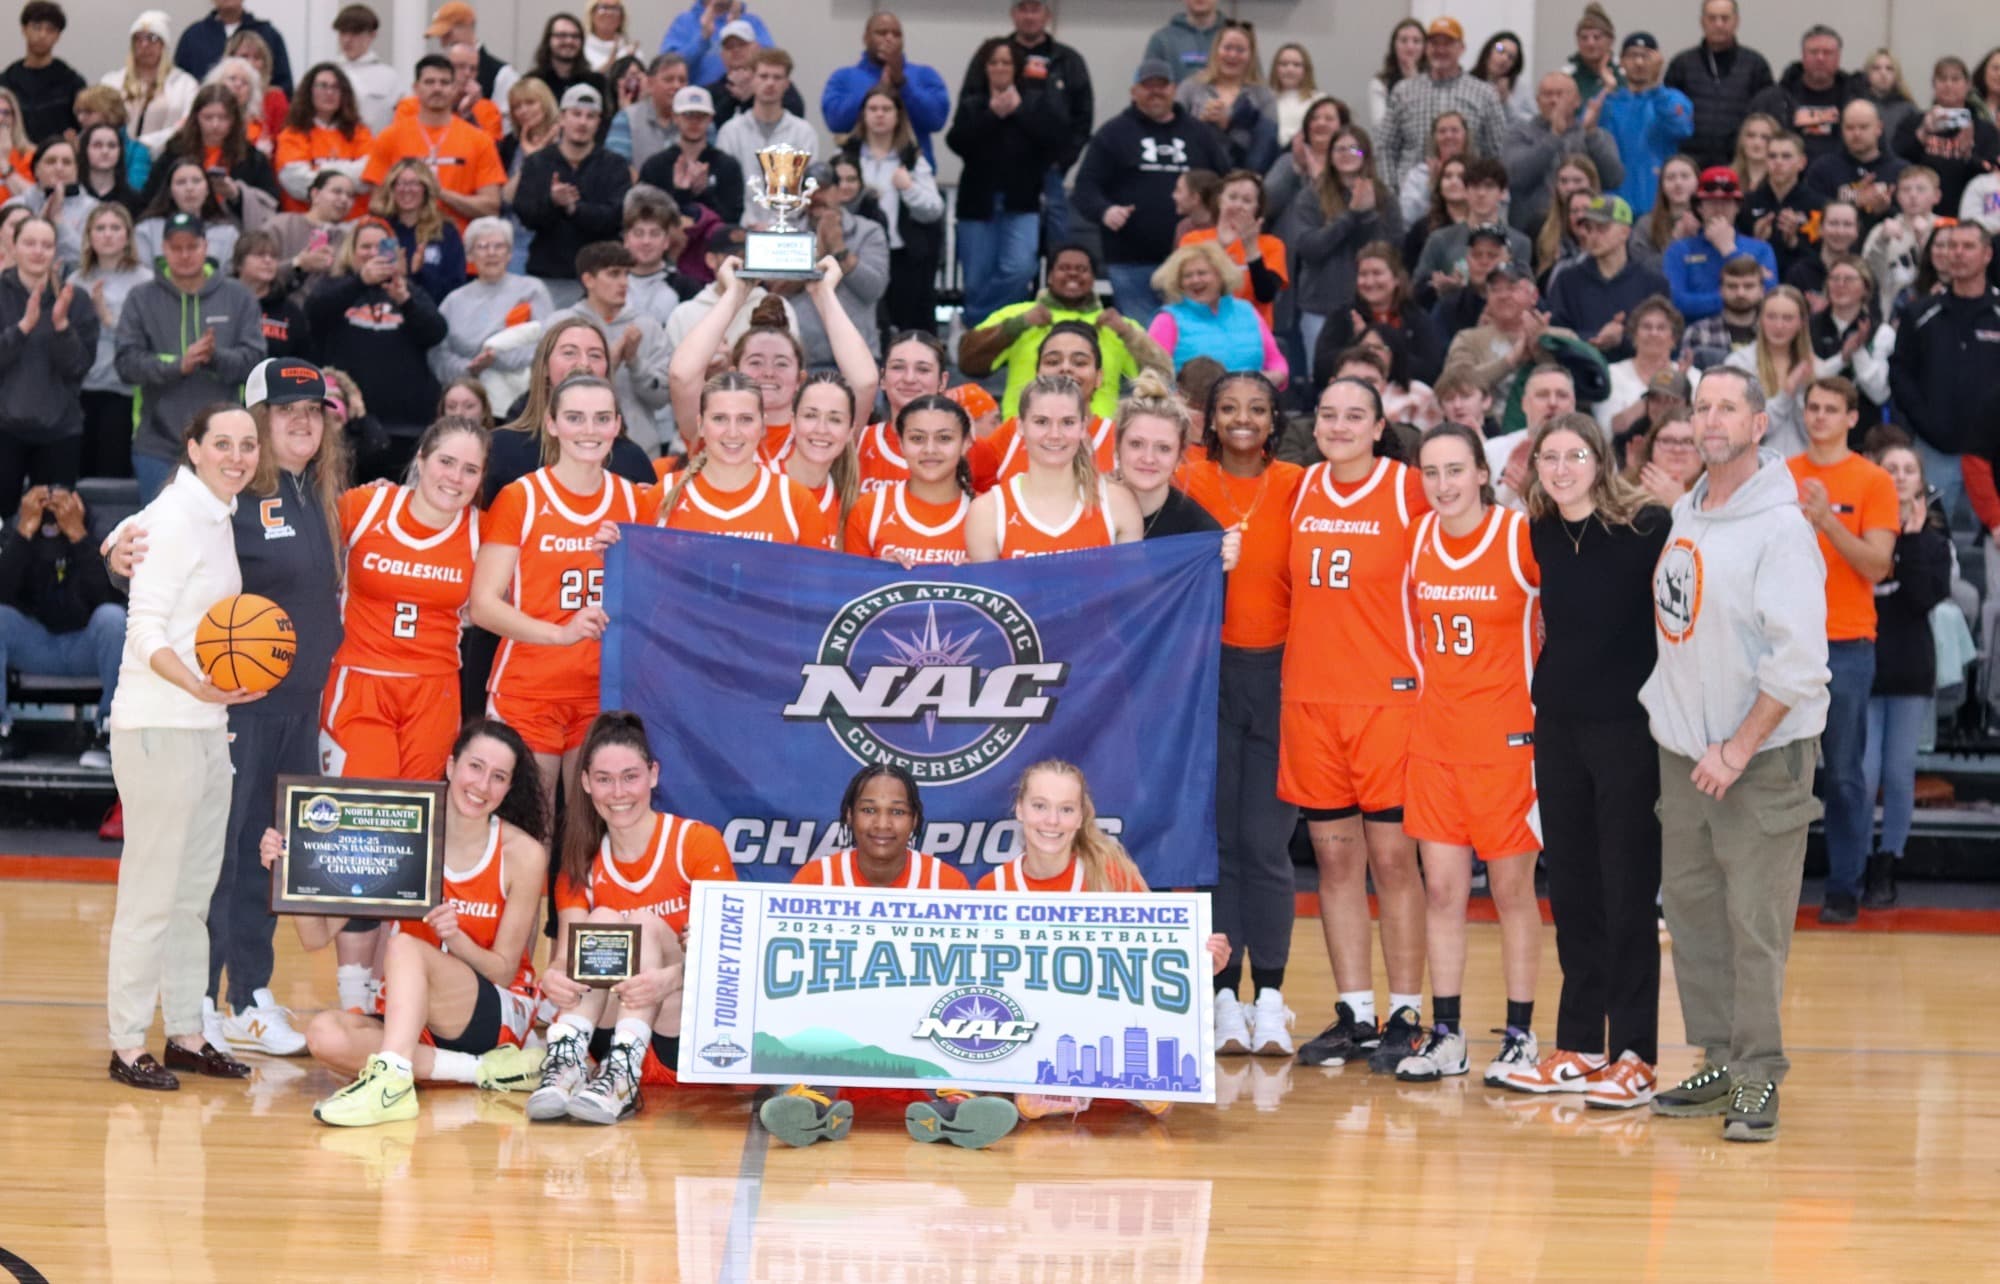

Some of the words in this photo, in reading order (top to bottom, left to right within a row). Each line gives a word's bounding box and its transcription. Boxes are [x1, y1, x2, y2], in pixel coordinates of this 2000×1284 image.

[261, 498, 284, 528] C
[1299, 516, 1381, 535] COBLESKILL
[539, 534, 594, 552] COBLE
[362, 552, 464, 584] COBLESKILL
[1309, 547, 1352, 590] 12
[560, 568, 605, 611] 25
[1416, 581, 1498, 601] COBLESKILL
[393, 601, 419, 639] 2
[830, 591, 904, 652] NORTH
[916, 587, 1033, 651] ATLANTIC
[1431, 613, 1475, 656] 13
[782, 662, 1069, 719] NAC
[846, 725, 1013, 777] CONFERENCE
[303, 811, 342, 823] NAC
[344, 808, 373, 818] NORTH
[375, 809, 416, 819] ATLANTIC
[352, 817, 408, 827] CONFERENCE
[304, 841, 349, 852] WOMEN'S
[350, 844, 414, 855] BASKETBALL
[338, 835, 380, 846] 2024-25
[319, 855, 398, 867] CONFERENCE
[327, 864, 388, 876] CHAMPION
[720, 894, 745, 952] TICKET
[767, 897, 861, 917] NORTH
[869, 901, 1008, 921] ATLANTIC
[1016, 905, 1189, 924] CONFERENCE
[777, 921, 877, 936] 2024-25
[892, 926, 1005, 941] WOMEN'S
[1020, 928, 1179, 944] BASKETBALL
[763, 936, 1192, 1016] CHAMPIONS
[714, 954, 741, 1028] TOURNEY
[932, 987, 966, 1015] NORTH
[969, 987, 1022, 1017] ATLANTIC
[912, 1018, 1038, 1041] NAC
[940, 1040, 1013, 1059] CONFERENCE
